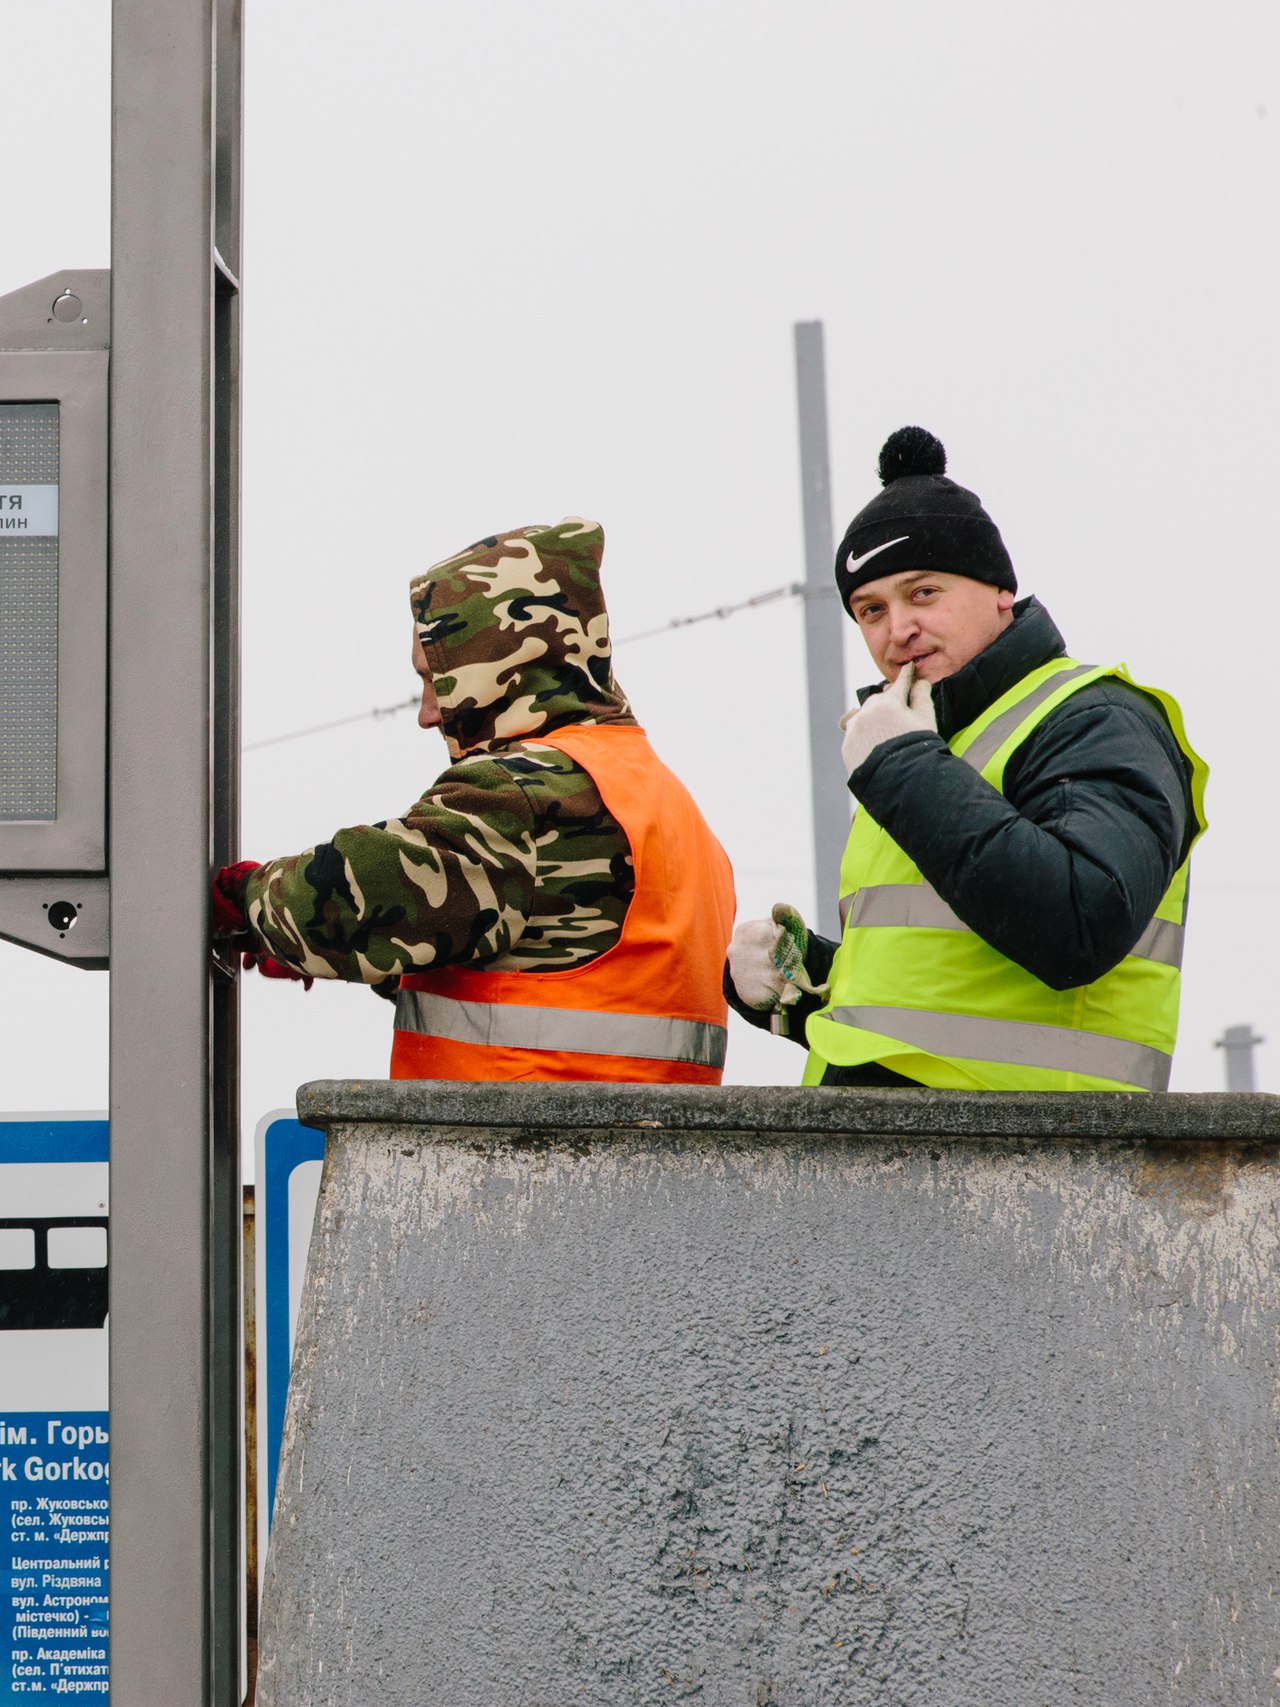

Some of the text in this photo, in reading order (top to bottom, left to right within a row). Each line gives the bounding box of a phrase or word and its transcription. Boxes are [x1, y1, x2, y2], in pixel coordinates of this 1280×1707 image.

[0, 1421, 37, 1445] ім.
[11, 1498, 109, 1512] пр. Жуковсько
[11, 1514, 44, 1528] (сел.
[11, 1532, 30, 1541] ст.
[35, 1532, 49, 1541] м.
[12, 1557, 100, 1570] Центральний
[11, 1575, 101, 1590] вул. Різдвяна
[12, 1597, 38, 1610] вул.
[16, 1610, 79, 1623] містечко)
[13, 1626, 87, 1640] (Південний
[12, 1647, 105, 1662] пр. Академіка
[12, 1663, 109, 1678] (сел. П'ятихат
[12, 1682, 46, 1692] ст.м.
